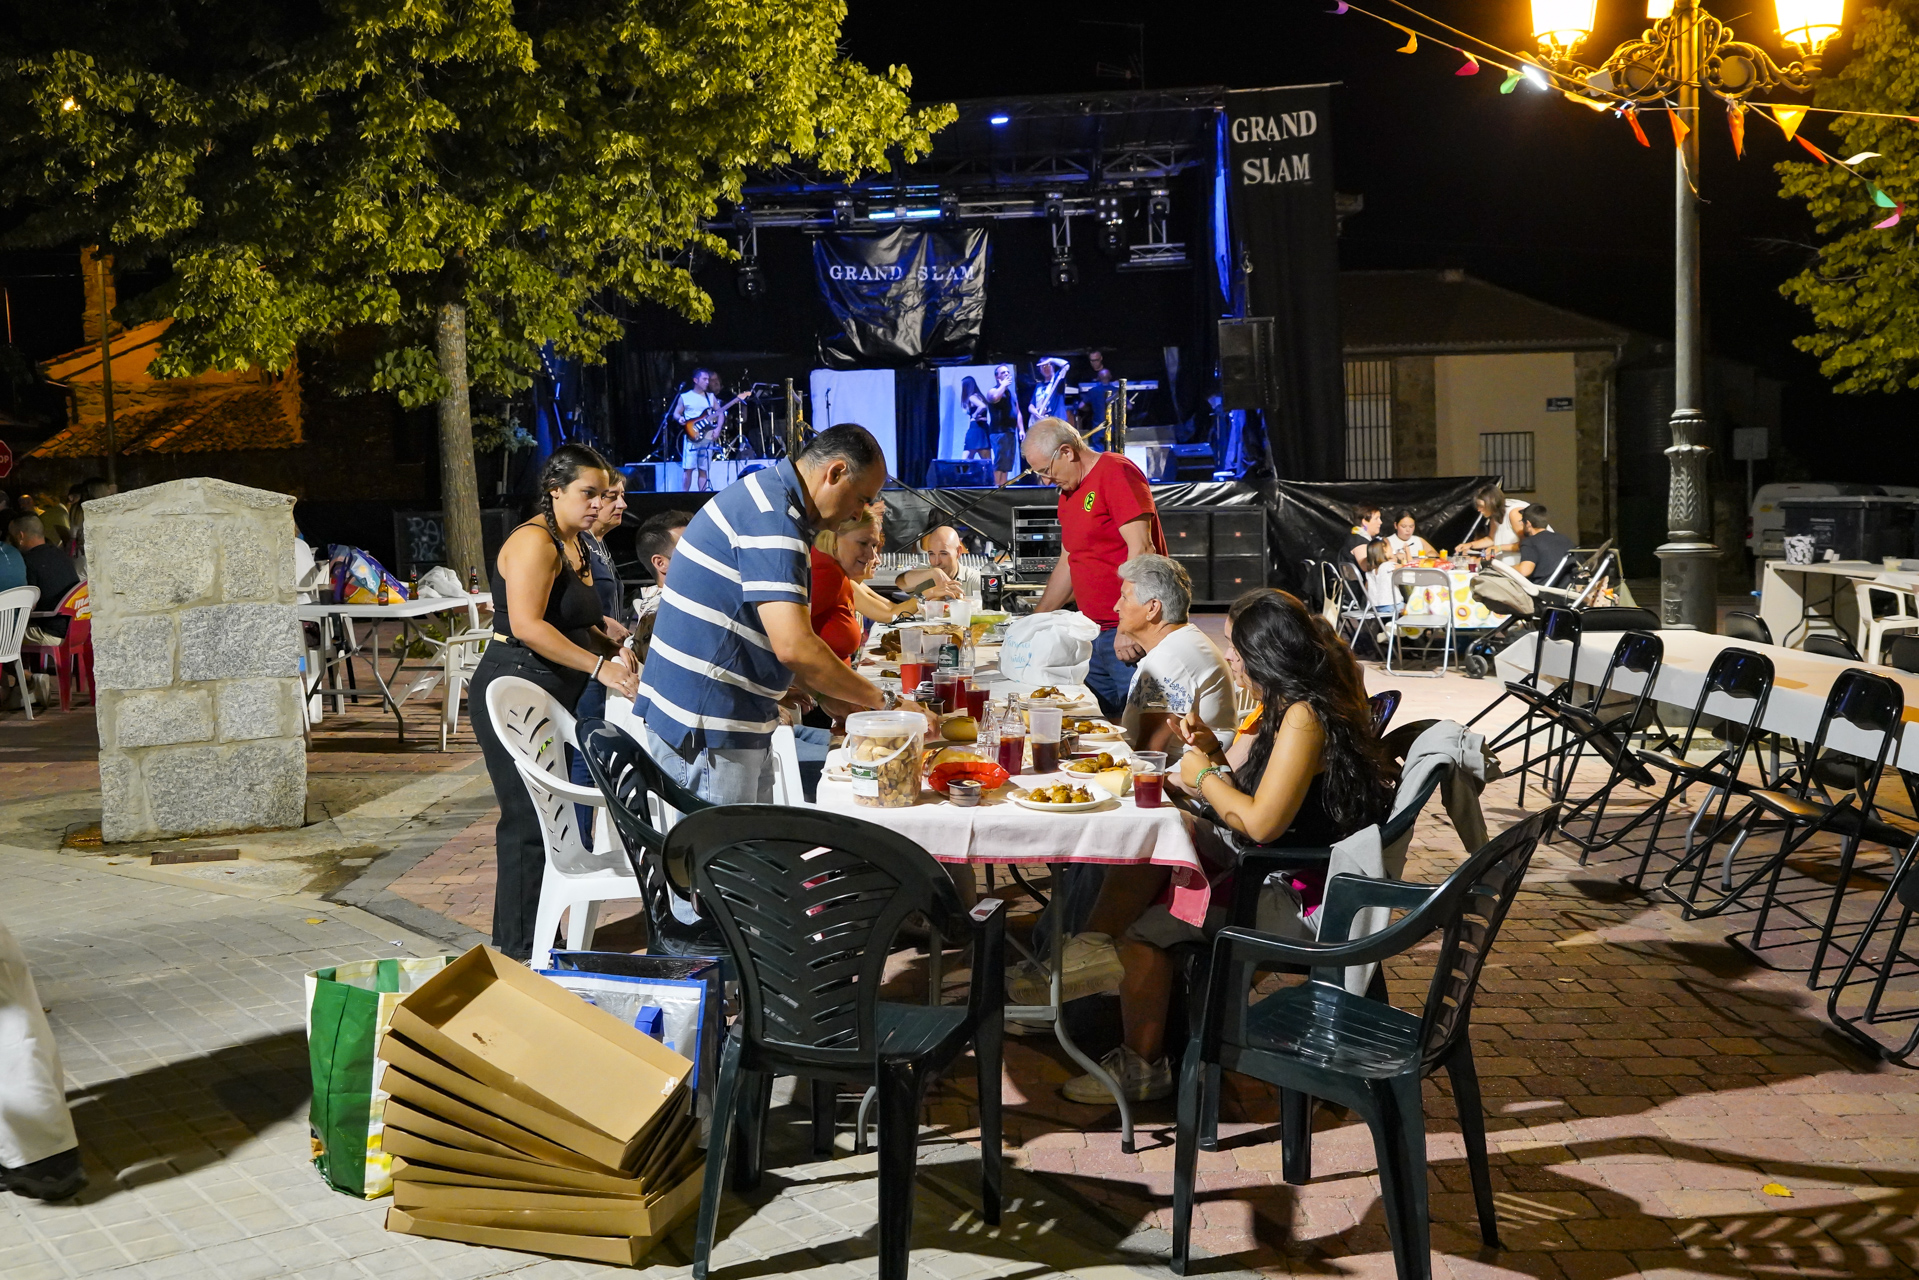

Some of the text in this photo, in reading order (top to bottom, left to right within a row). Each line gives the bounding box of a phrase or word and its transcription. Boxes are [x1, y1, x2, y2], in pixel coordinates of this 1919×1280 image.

[1232, 110, 1317, 143] GRAND
[1242, 153, 1310, 185] SLAM
[829, 265, 975, 281] GRAND SLAM
